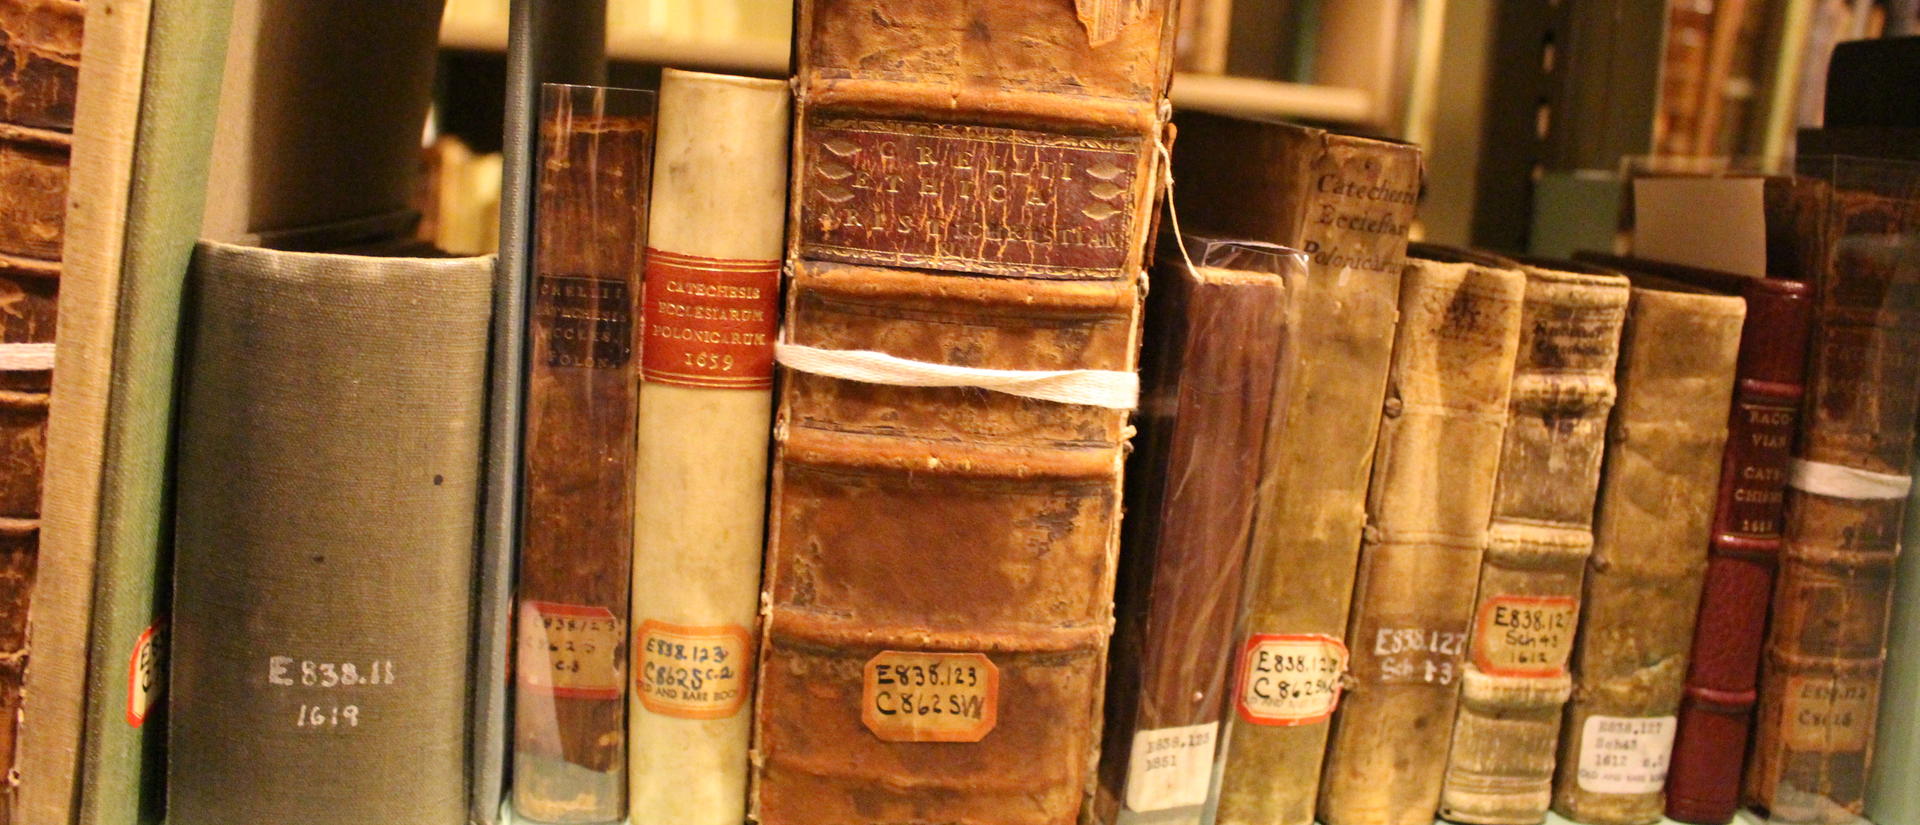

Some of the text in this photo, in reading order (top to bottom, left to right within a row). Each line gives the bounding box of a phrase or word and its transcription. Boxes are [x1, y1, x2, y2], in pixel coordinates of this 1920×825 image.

[852, 171, 1053, 207] ETHICA
[666, 280, 761, 300] CATECHESIS
[658, 301, 765, 322] ECCLESIARUM
[652, 324, 766, 346] POLONICARUM
[684, 352, 734, 371] 1659
[876, 664, 978, 688] E838.123
[296, 704, 360, 728] 1619
